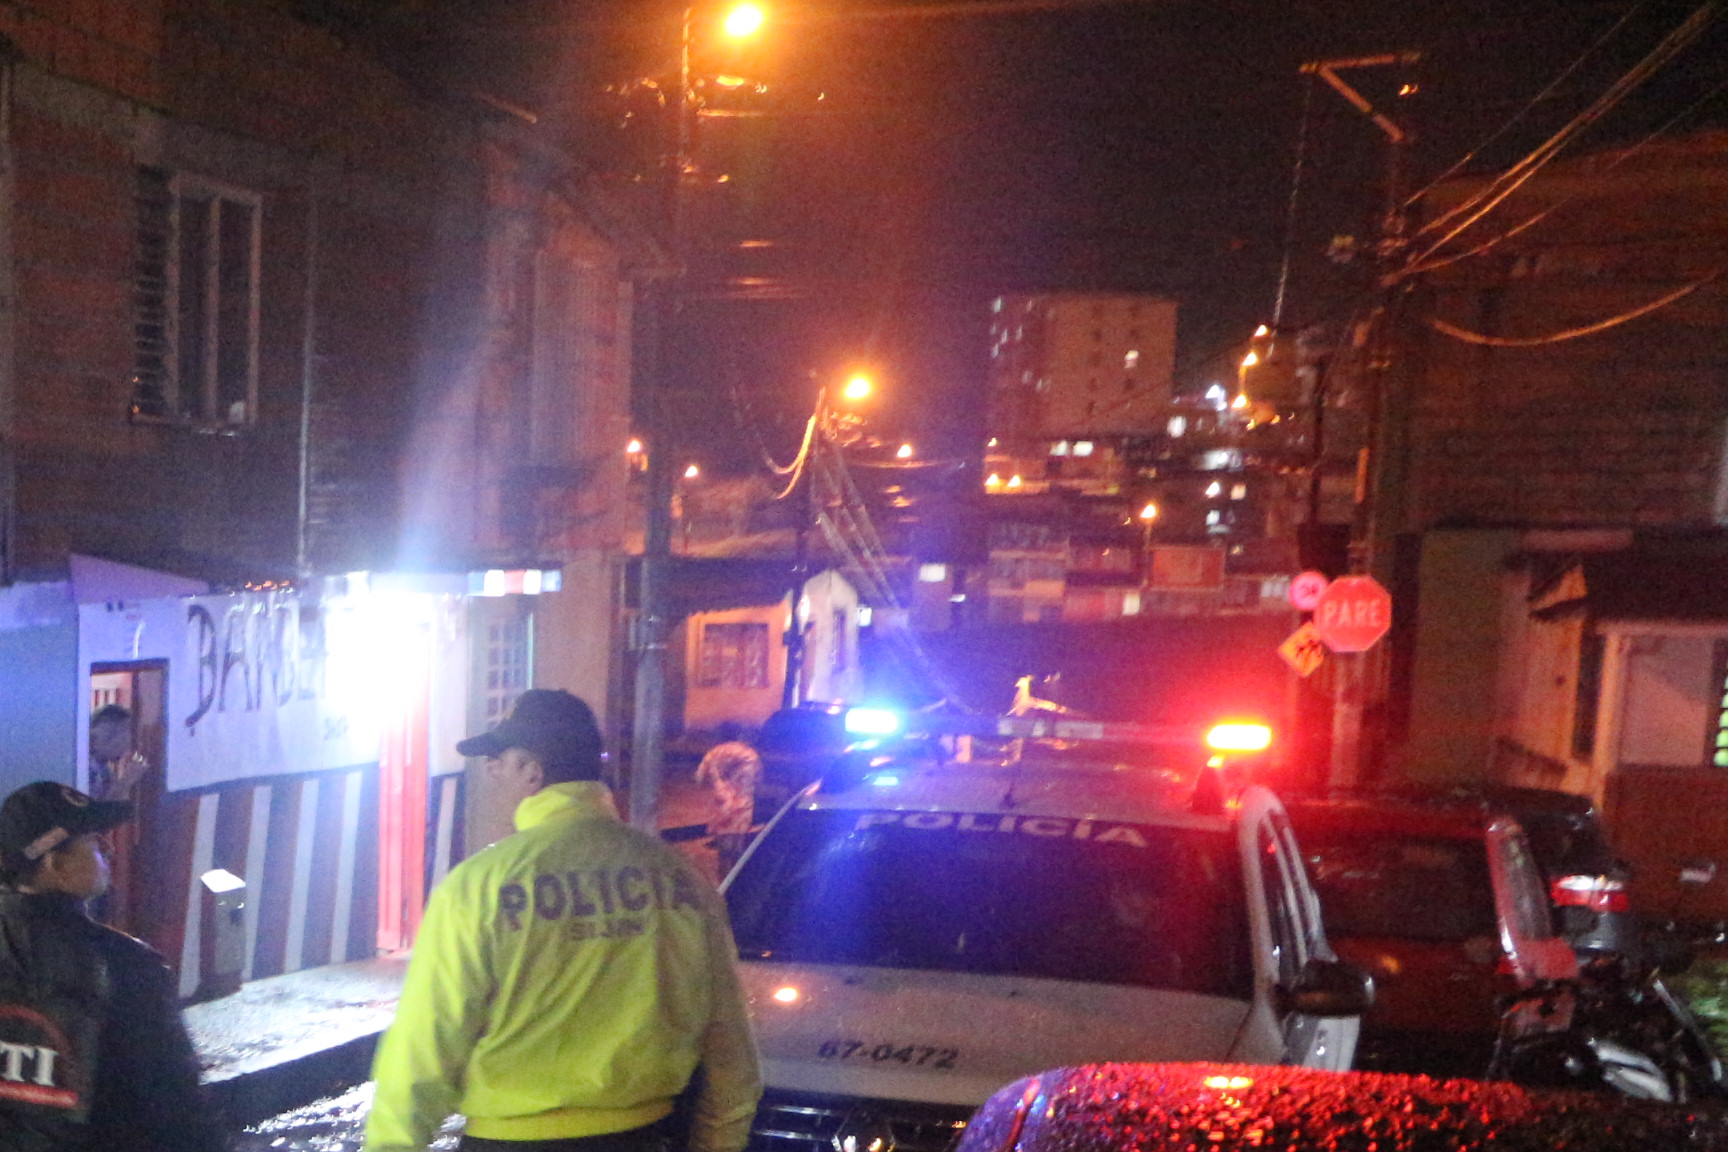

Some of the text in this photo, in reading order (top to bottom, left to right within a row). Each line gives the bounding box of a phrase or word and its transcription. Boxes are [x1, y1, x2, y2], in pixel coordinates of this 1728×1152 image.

[1323, 598, 1381, 628] PARE
[498, 866, 702, 932] POLICIA
[817, 1039, 960, 1069] 67-0472
